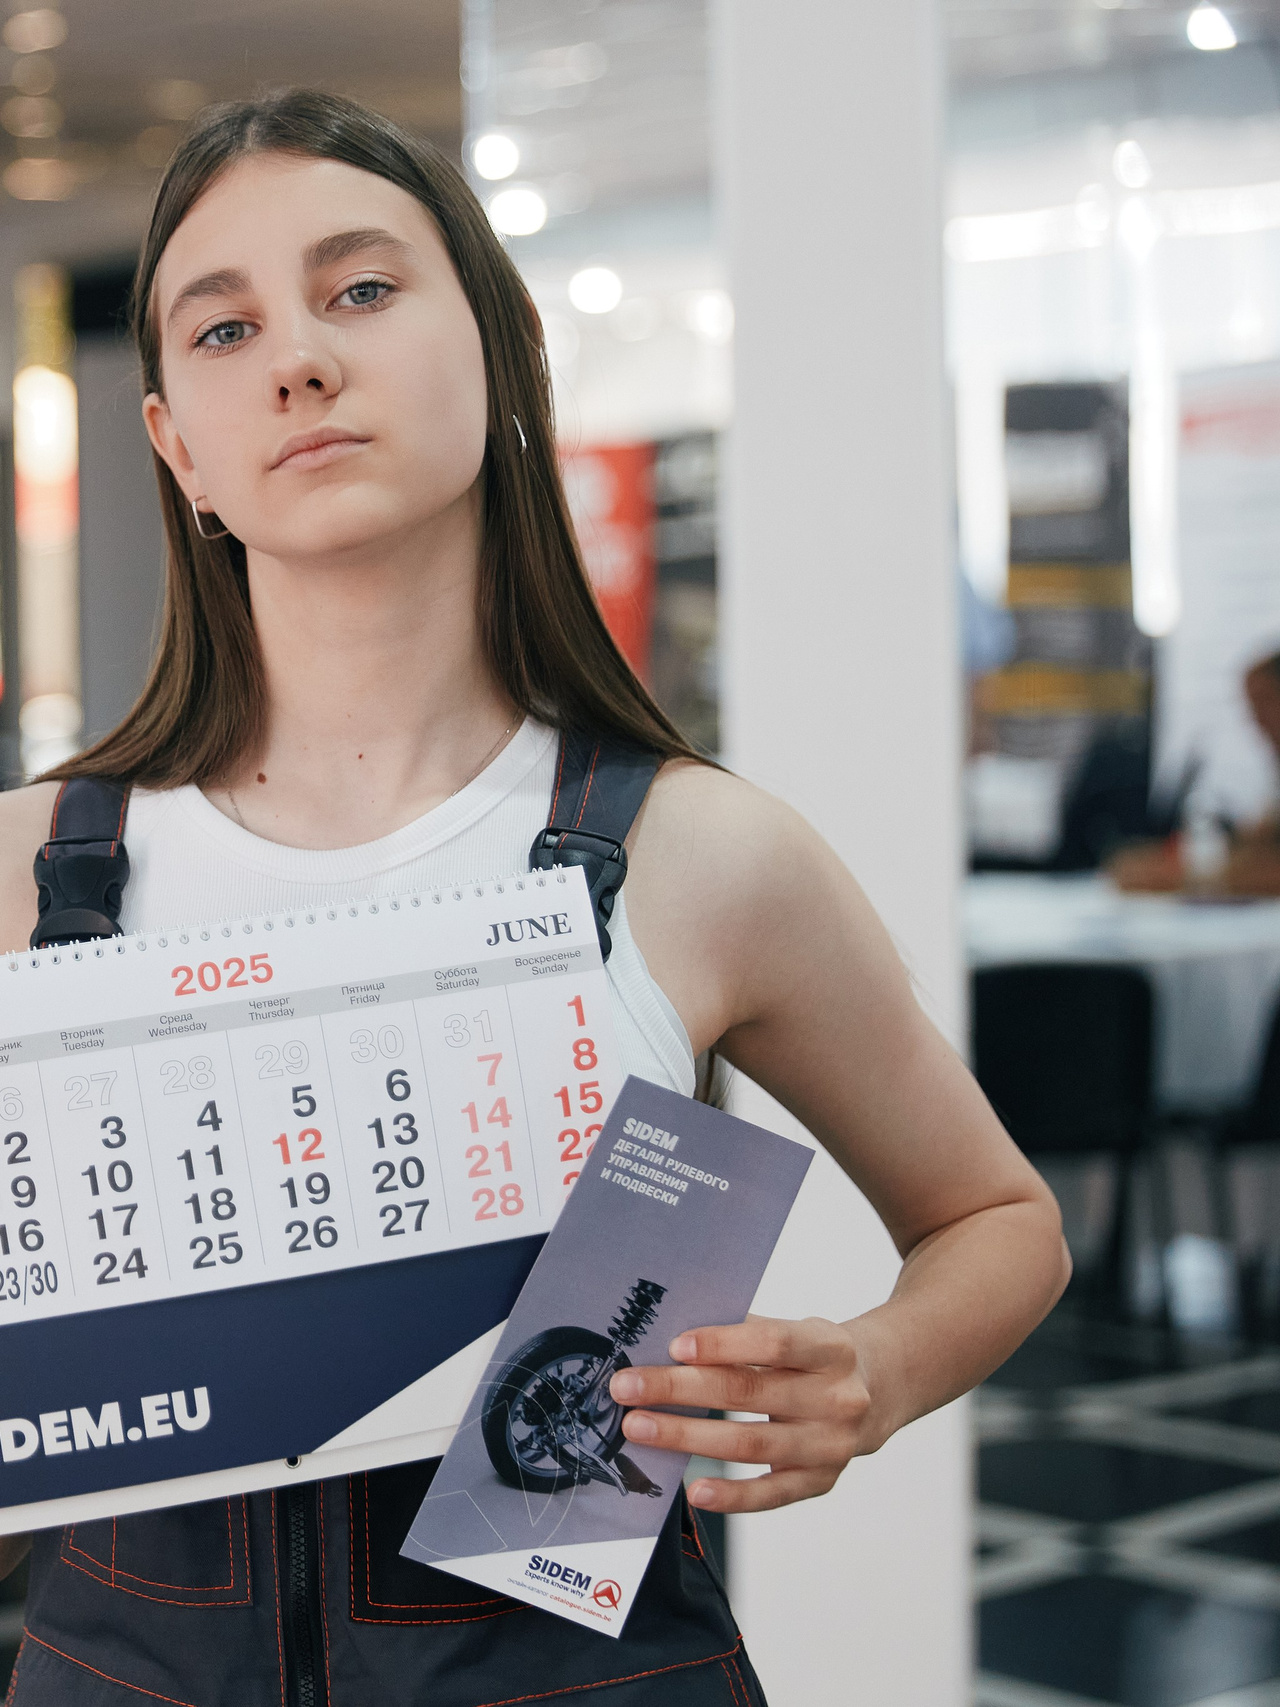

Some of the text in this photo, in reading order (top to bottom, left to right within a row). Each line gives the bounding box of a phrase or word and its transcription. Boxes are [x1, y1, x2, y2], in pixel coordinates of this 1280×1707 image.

[486, 912, 572, 946] JUNE
[434, 965, 478, 981] Суббота
[514, 949, 582, 968] Воскресенье
[532, 961, 569, 977] Sunday
[170, 952, 273, 996] 2025
[435, 975, 481, 992] Saturday
[248, 996, 291, 1011] Четверг
[341, 981, 386, 997] Пятница
[349, 992, 381, 1006] Friday
[159, 1011, 194, 1026] Среда
[248, 1006, 296, 1023] Thursday
[60, 1026, 105, 1042] Вторник
[148, 1020, 208, 1039] Wednesday
[62, 1036, 105, 1054] Tuesday
[63, 1070, 119, 1112] 27
[159, 1055, 216, 1096] 28
[254, 1040, 310, 1080] 29
[349, 1024, 405, 1064] 30
[443, 1009, 494, 1049] 31
[566, 995, 587, 1027] 1
[3, 1131, 31, 1165] 2
[100, 1116, 127, 1150] 3
[196, 1100, 223, 1133] 4
[291, 1084, 317, 1119] 5
[385, 1068, 412, 1102] 6
[476, 1053, 504, 1087] 7
[572, 1037, 599, 1071] 8
[10, 1175, 37, 1209] 9
[81, 1160, 134, 1197] 10
[176, 1144, 224, 1181] 11
[271, 1127, 326, 1166] 12
[367, 1112, 420, 1150] 13
[460, 1097, 513, 1134] 14
[553, 1080, 604, 1119] 15
[622, 1117, 680, 1152] SIDEM
[607, 1153, 689, 1193] УПРАВЛЕНИЯ
[613, 1139, 730, 1192] ДЕТАЛИ РУЛЕВОГО
[88, 1203, 140, 1241] 17
[183, 1188, 237, 1226] 18
[279, 1172, 331, 1210] 19
[371, 1155, 426, 1195] 20
[464, 1140, 513, 1179] 21
[600, 1168, 680, 1207] И ПОДВЕСКИ
[92, 1247, 149, 1285] 24
[188, 1231, 244, 1270] 25
[284, 1215, 339, 1254] 26
[378, 1199, 431, 1238] 27
[471, 1183, 525, 1222] 28
[524, 1569, 585, 1599] Experts know why
[528, 1555, 592, 1591] SIDEM
[550, 1594, 612, 1622] catalogue.sidem.be
